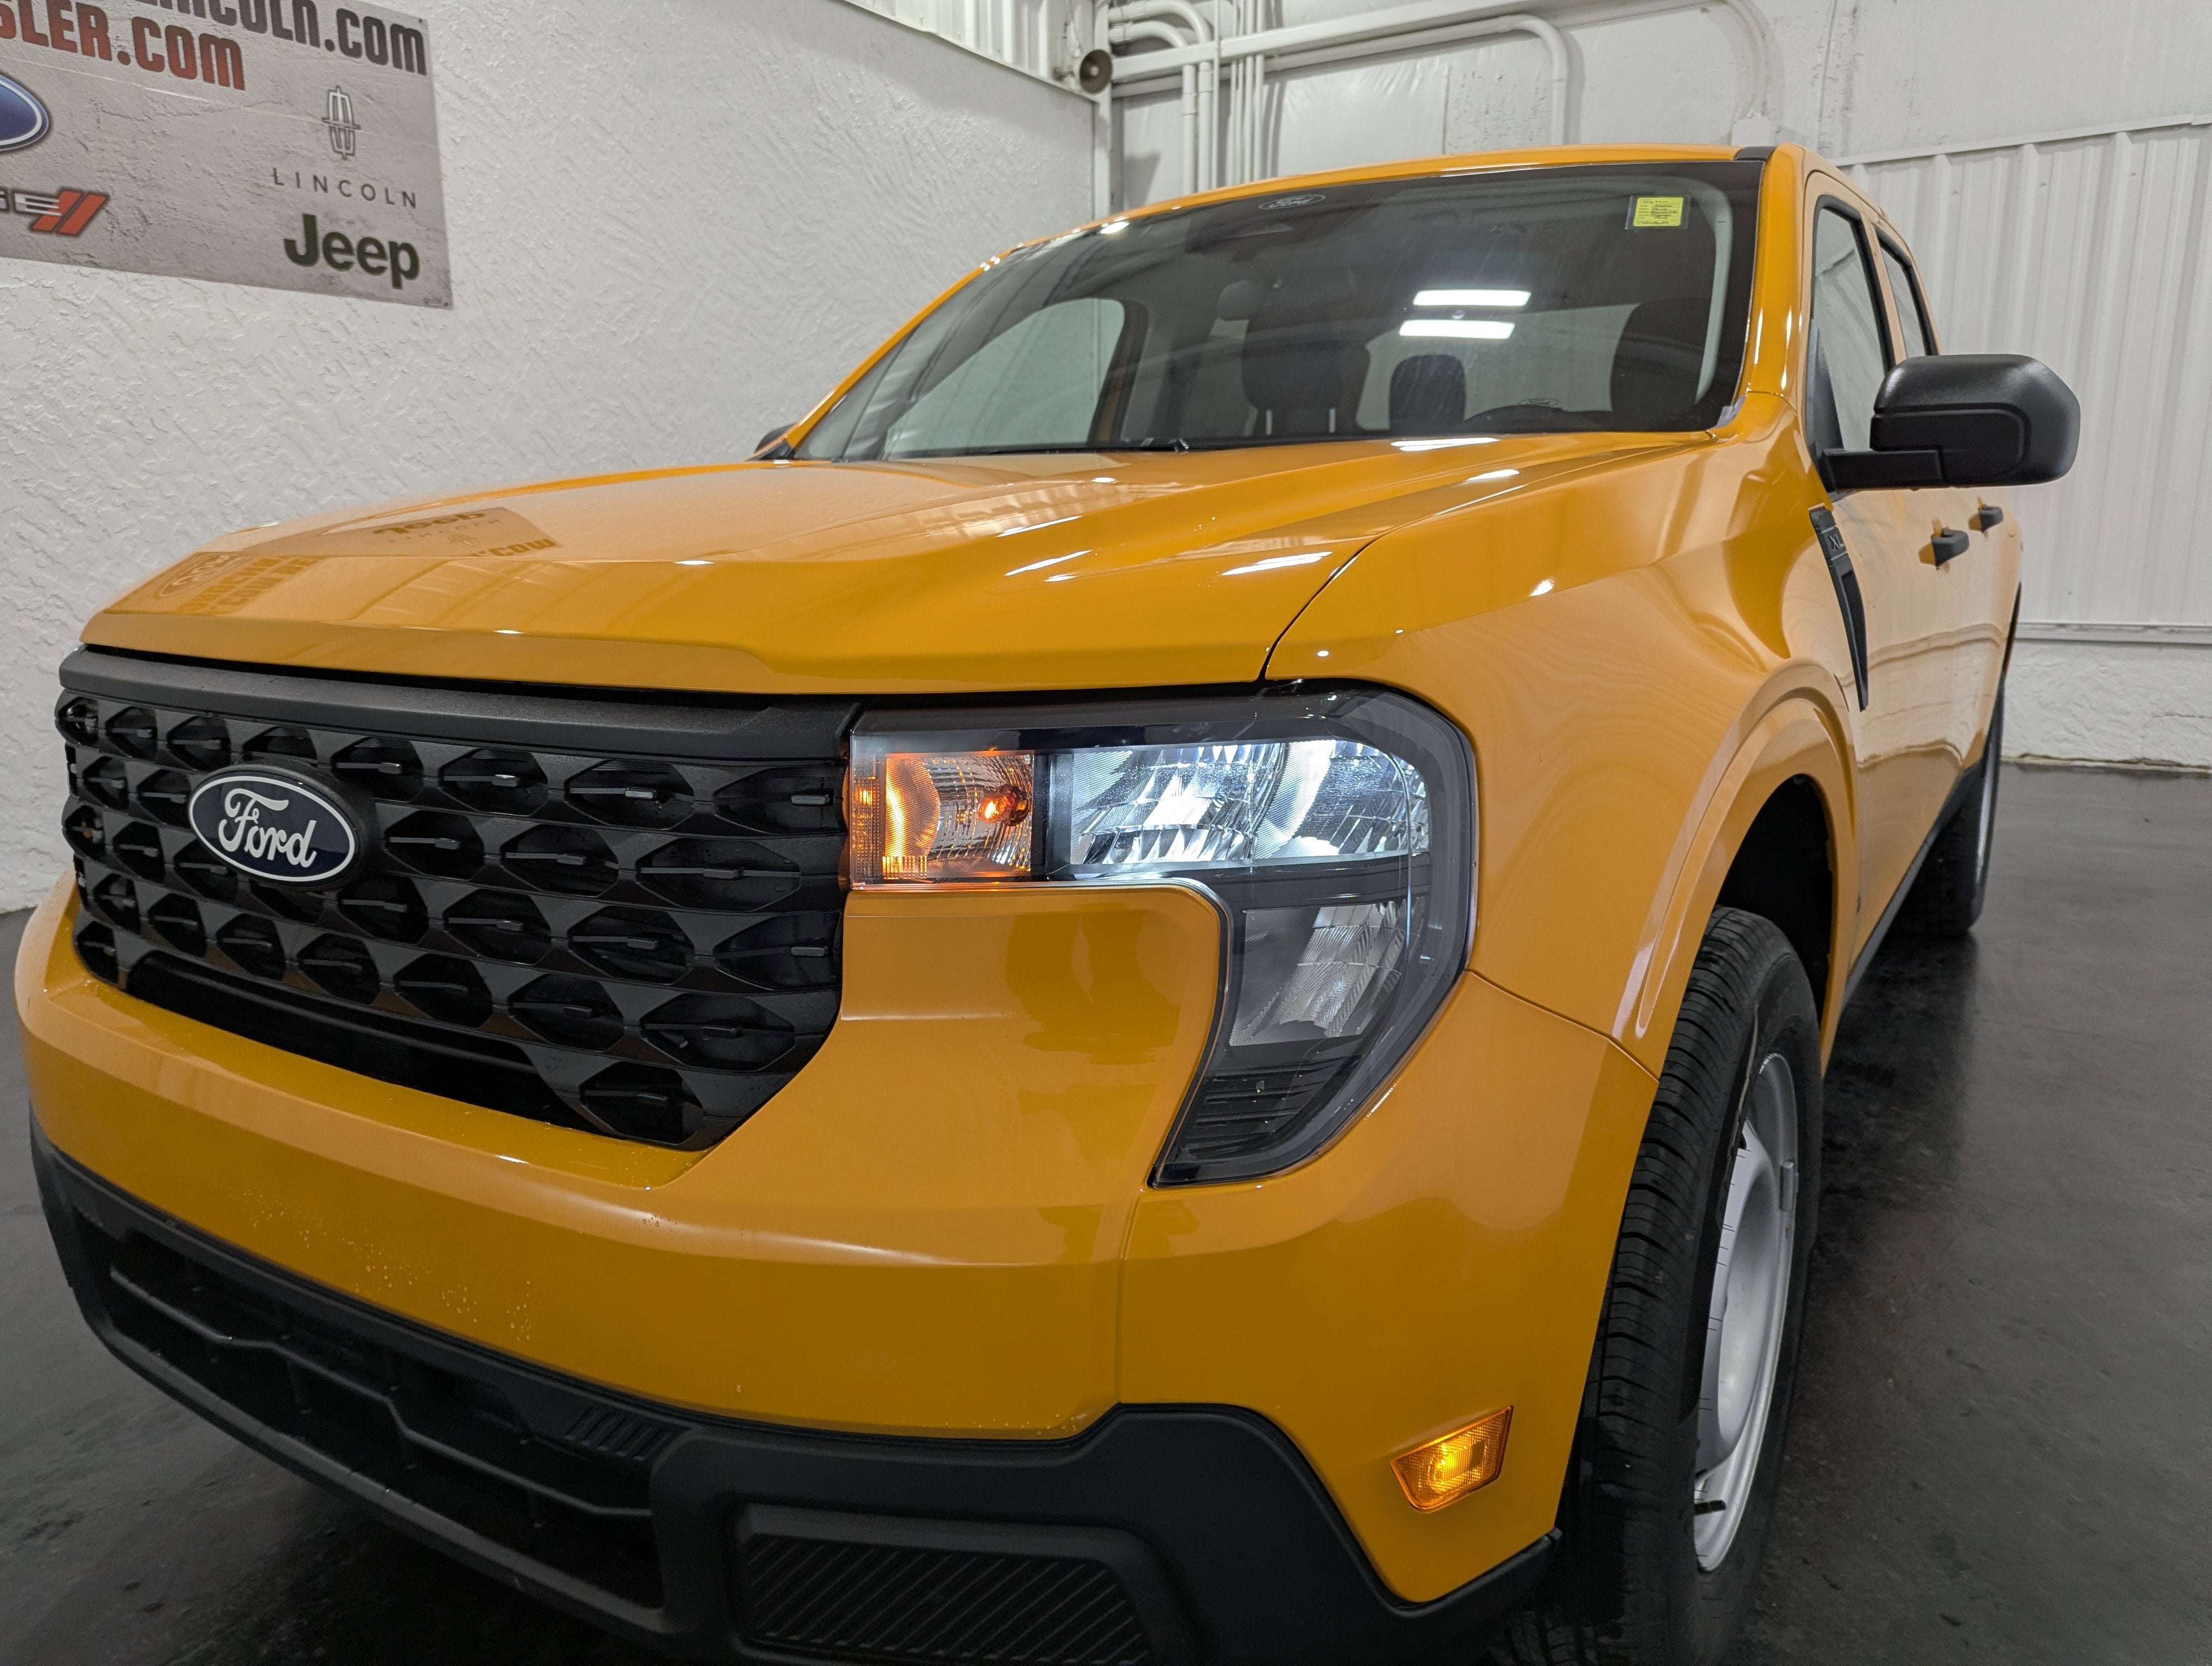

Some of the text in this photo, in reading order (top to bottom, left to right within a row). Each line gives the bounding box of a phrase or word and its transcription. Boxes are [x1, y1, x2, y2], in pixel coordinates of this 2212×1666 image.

[133, 0, 427, 75] COLN.COM
[273, 168, 416, 209] LINCOLN
[283, 213, 420, 290] Jeep
[1828, 533, 1844, 551] XL
[218, 788, 317, 868] Ford
